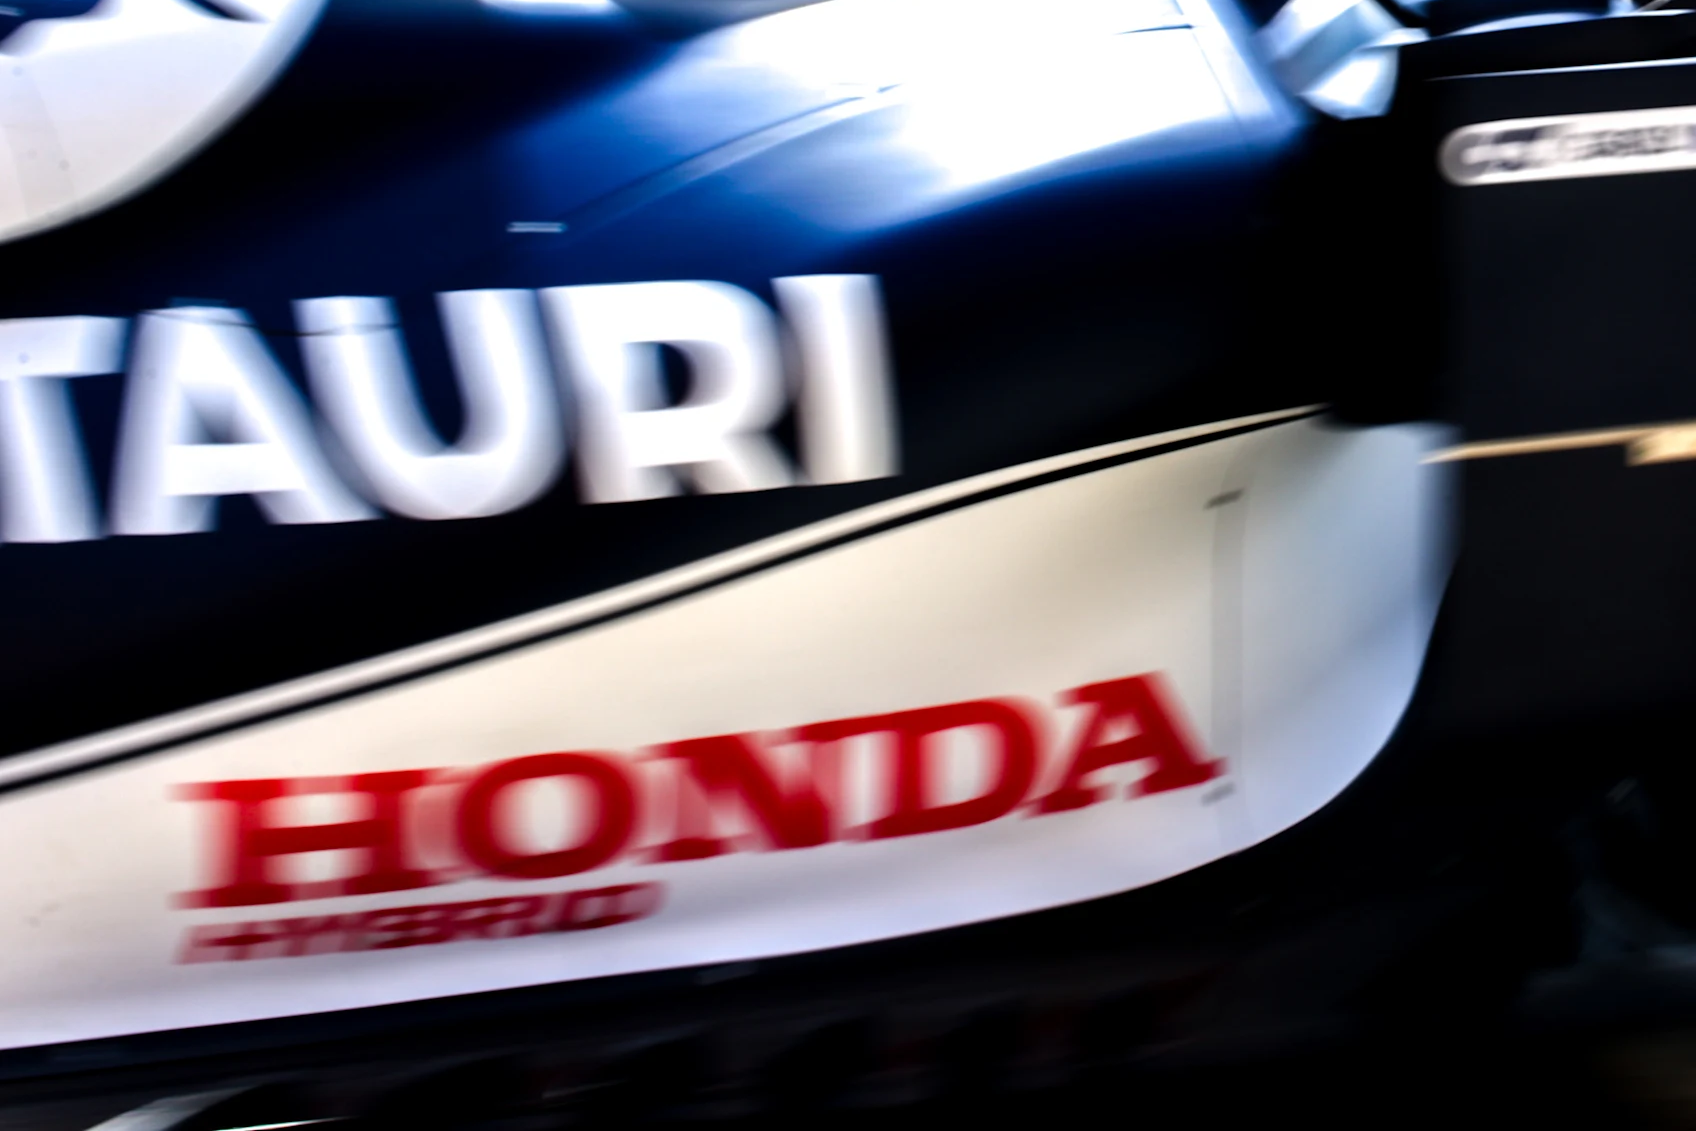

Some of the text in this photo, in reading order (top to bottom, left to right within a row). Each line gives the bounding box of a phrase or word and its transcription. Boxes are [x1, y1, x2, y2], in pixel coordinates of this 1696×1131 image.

[0, 272, 905, 544] TAURI
[166, 670, 1225, 910] HONDA
[174, 880, 667, 966] HYBRID
